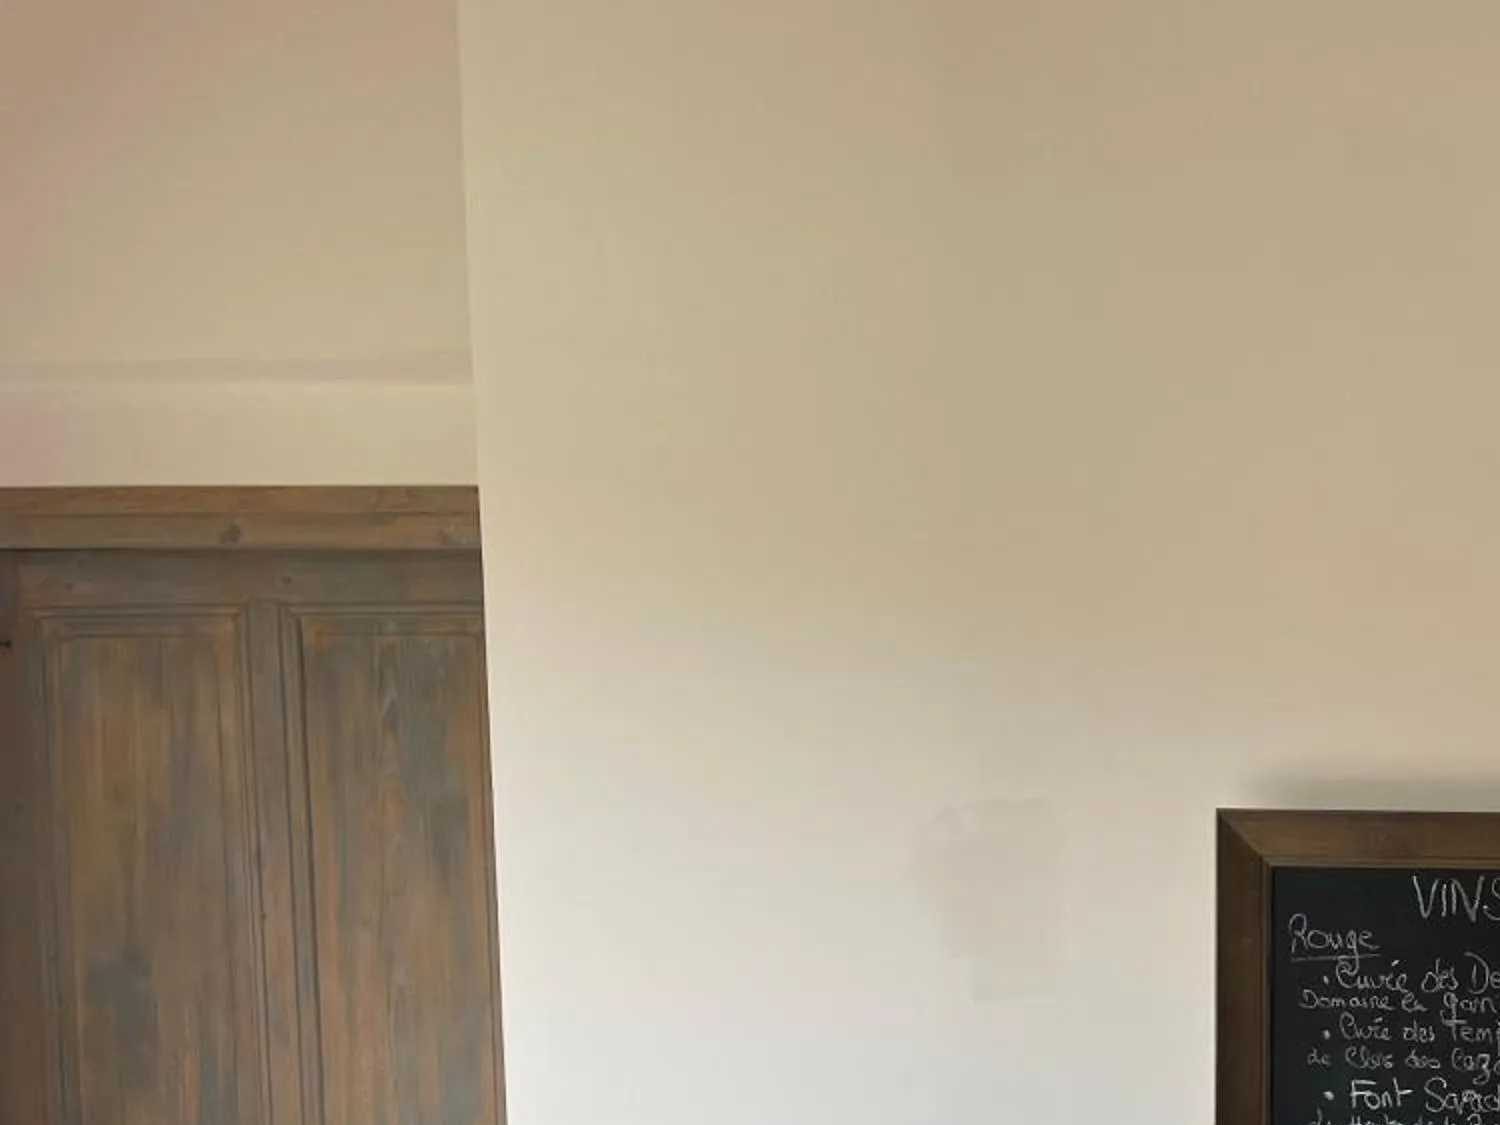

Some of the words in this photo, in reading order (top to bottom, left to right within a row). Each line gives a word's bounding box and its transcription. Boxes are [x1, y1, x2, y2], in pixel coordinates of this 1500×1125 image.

[1289, 913, 1380, 974] Rouge
[1299, 988, 1396, 1011] Domaine
[1349, 1077, 1413, 1110] Font
